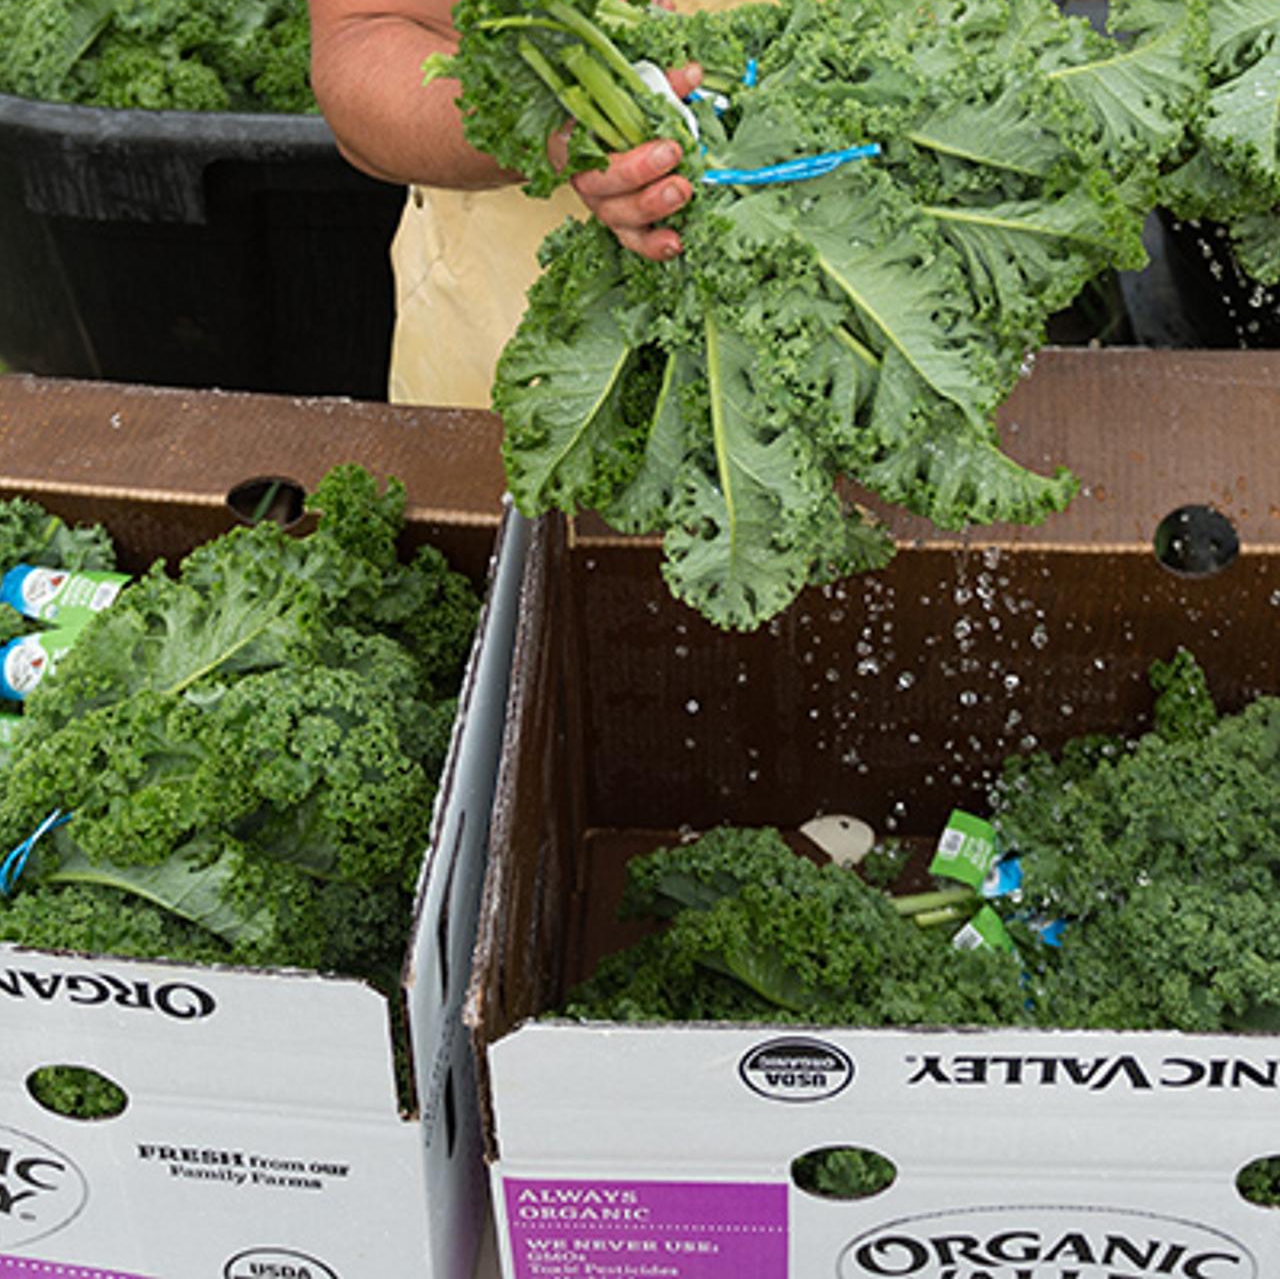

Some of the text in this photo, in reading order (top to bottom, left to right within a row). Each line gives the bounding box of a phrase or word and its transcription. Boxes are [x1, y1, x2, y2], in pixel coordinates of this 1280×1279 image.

[764, 1072, 827, 1088] USDA
[906, 1054, 1153, 1090] VALLEY
[136, 1143, 351, 1177] FRESH from our
[169, 1163, 324, 1191] Family Farms
[518, 1188, 638, 1204] ALWAYS
[518, 1205, 651, 1221] ORGANIC
[525, 1238, 567, 1251] WE
[573, 1238, 658, 1252] NEVER
[854, 1231, 1241, 1279] ORGANIC
